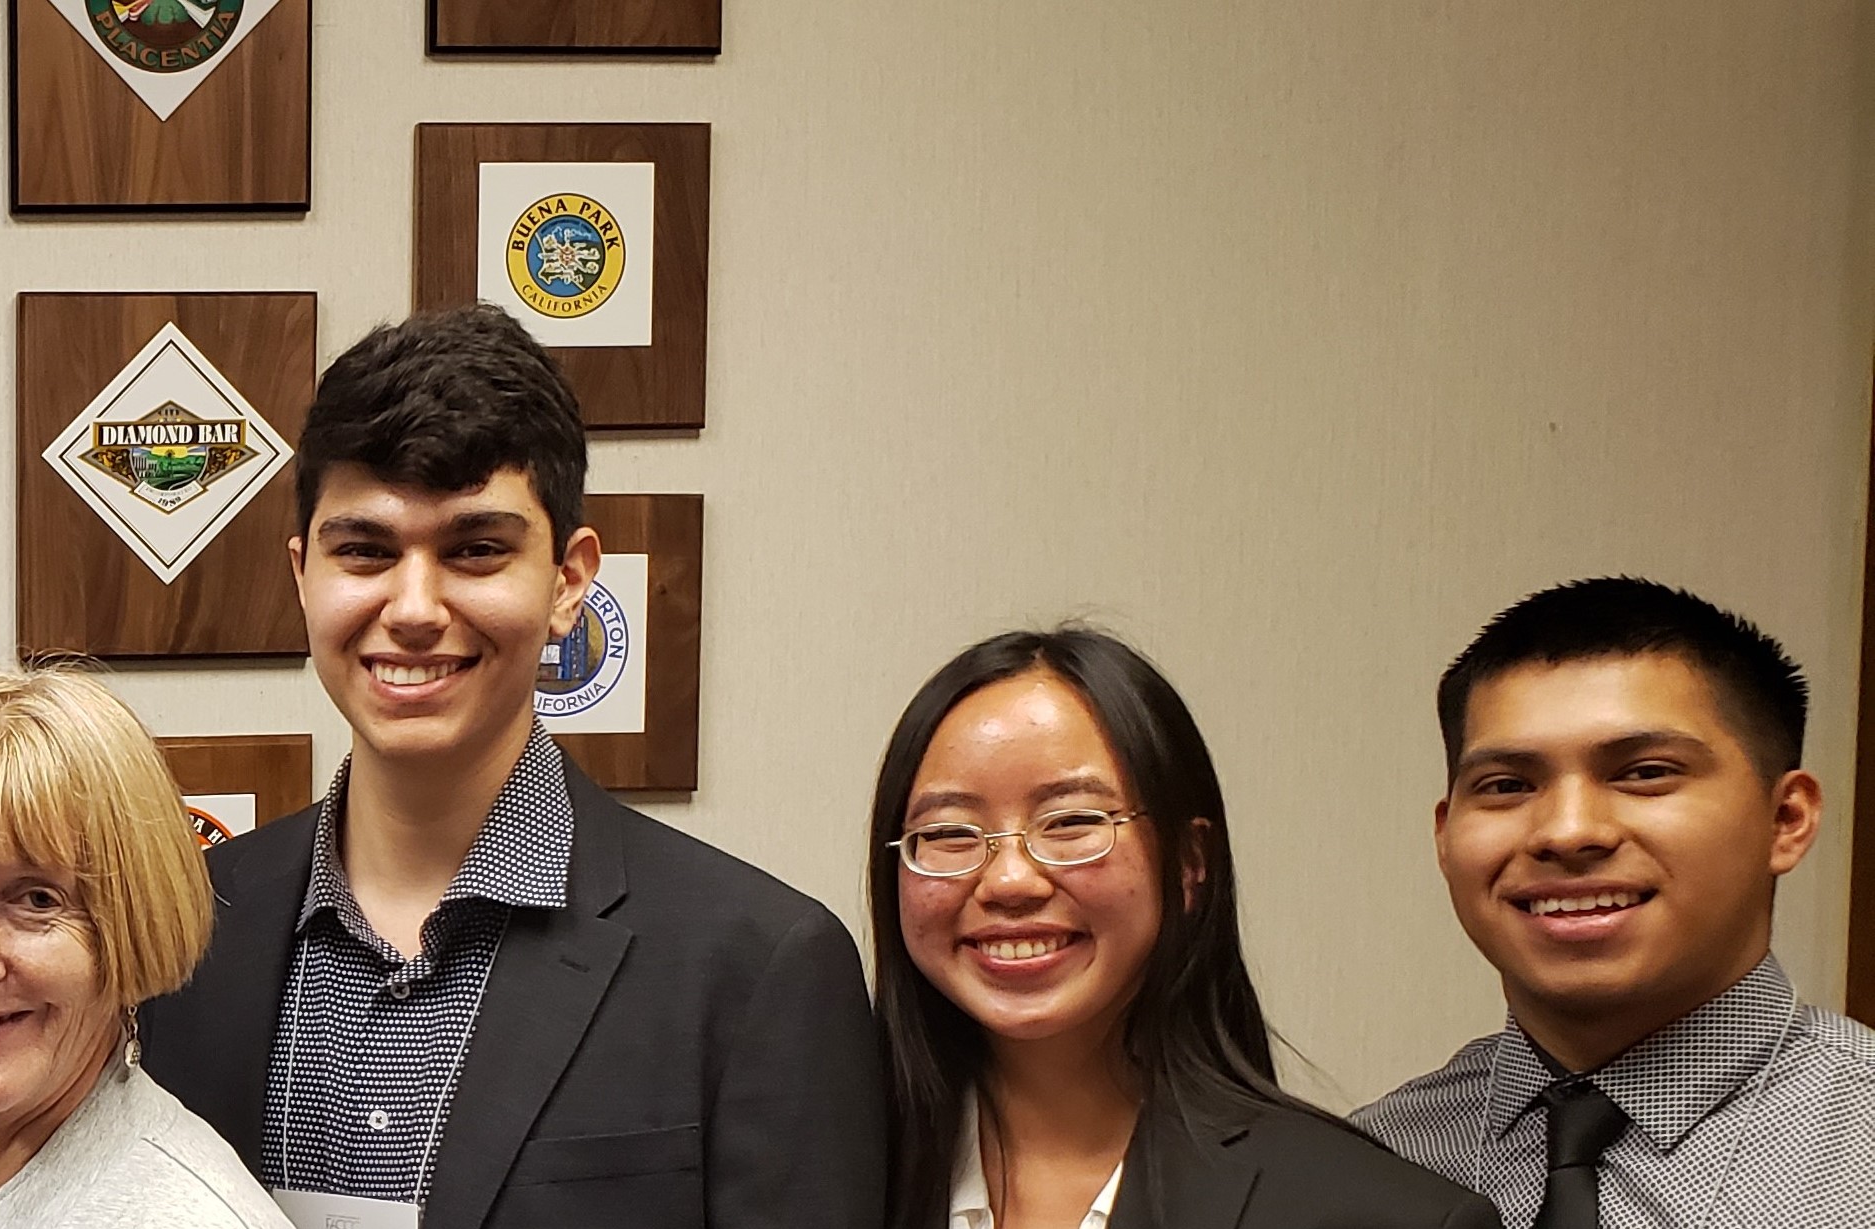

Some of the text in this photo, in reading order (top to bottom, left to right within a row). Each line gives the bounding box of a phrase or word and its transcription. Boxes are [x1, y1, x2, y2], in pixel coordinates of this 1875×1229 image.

[96, 11, 235, 67] PLACENTIA
[511, 198, 620, 252] BUENA PARK
[522, 284, 608, 312] CALIFORNIA
[102, 423, 239, 446] DIAMOND BAR
[586, 590, 624, 659] ERTON
[534, 682, 606, 711] IFORNIA
